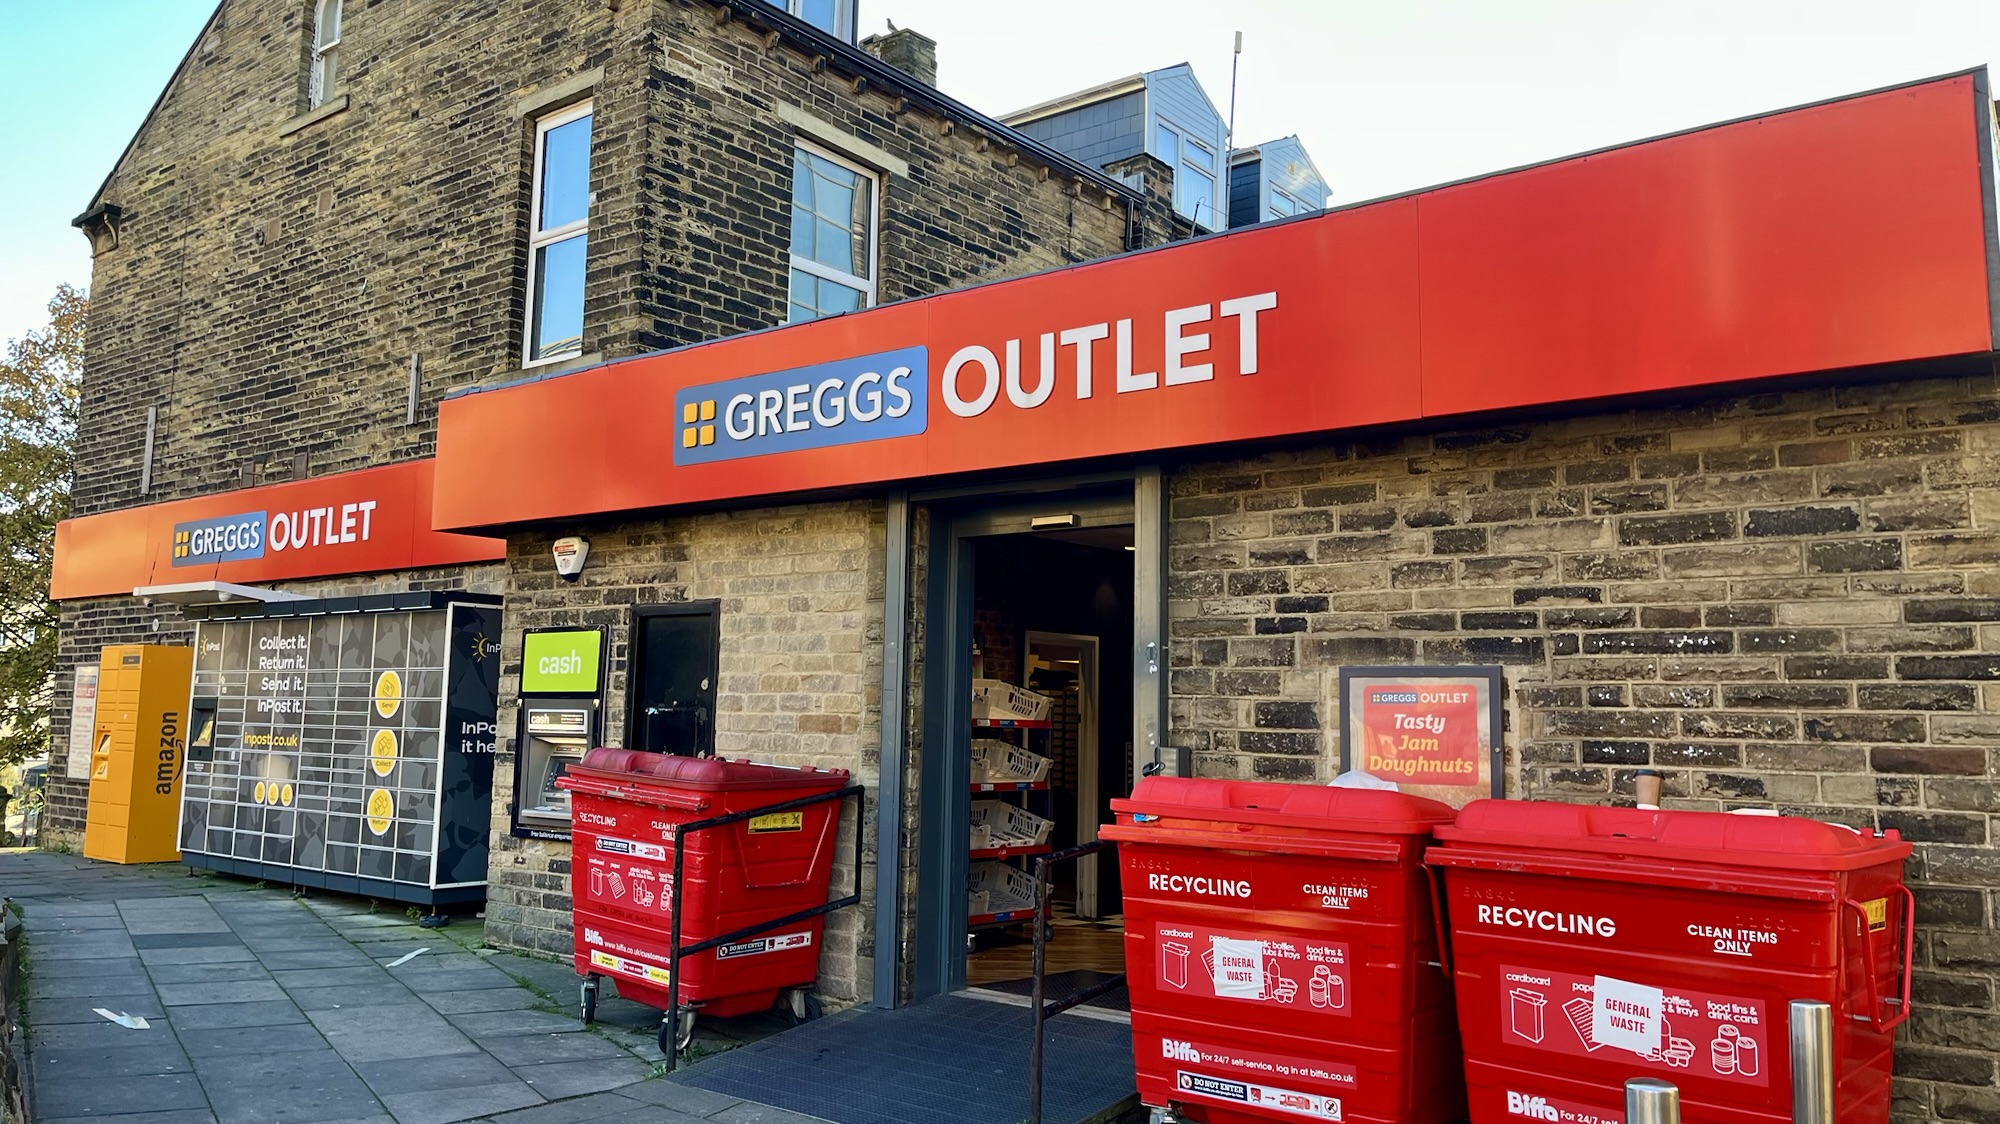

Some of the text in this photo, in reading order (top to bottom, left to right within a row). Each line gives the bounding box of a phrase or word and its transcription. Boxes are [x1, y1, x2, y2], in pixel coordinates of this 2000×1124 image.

[725, 291, 1277, 440] GREGGS OUTLET
[191, 500, 377, 556] GREGGS OUTLET
[206, 642, 220, 652] InPost
[260, 635, 308, 650] Collect it.
[486, 643, 501, 653] InP
[259, 655, 306, 670] Return it.
[539, 649, 582, 675] cash
[261, 676, 304, 691] Send it.
[257, 699, 302, 713] InPost it.
[1381, 693, 1469, 704] GREGGS OUTLET
[531, 713, 550, 724] cash
[1394, 713, 1446, 734] Tasty
[462, 721, 497, 735] InPo
[244, 732, 298, 747] inpost.co.uk
[462, 739, 496, 753] it he
[1398, 735, 1439, 751] Jam
[156, 711, 178, 795] amazon
[1369, 755, 1473, 777] Doughnuts
[580, 812, 616, 827] RECYCLING
[651, 820, 671, 831] CLEAN
[661, 830, 676, 841] ONL
[1149, 874, 1252, 898] RECYCLING
[1303, 884, 1368, 899] CLEAN ITEMS
[1322, 896, 1349, 907] ONLY
[1478, 904, 1616, 937] RECYCLING
[584, 928, 604, 946] Biffa
[1160, 928, 1193, 939] cardboard
[1687, 924, 1732, 940] CLEAN
[1737, 929, 1778, 944] ITEMS
[1306, 945, 1343, 957] food tins &
[1714, 939, 1751, 953] ONLY
[1222, 956, 1256, 969] GENERAL
[1306, 953, 1344, 964] drink cans
[1226, 970, 1253, 982] WASTE
[1506, 972, 1551, 987] cardboard
[1572, 982, 1595, 994] pape
[1605, 997, 1652, 1019] GENERAL
[1667, 1004, 1675, 1013] &
[1676, 1005, 1699, 1018] trays
[1706, 1000, 1758, 1016] food tins &
[1610, 1015, 1645, 1034] WASTE
[1707, 1009, 1759, 1025] drink cans
[1162, 1038, 1354, 1083] Biffa For 24/7 self-service, log in at biffa.co.uk
[1194, 1078, 1244, 1094] DO NOT ENTER
[1507, 1090, 1559, 1122] Biffa
[1560, 1110, 1576, 1121] For
[1577, 1113, 1598, 1124] 24/7
